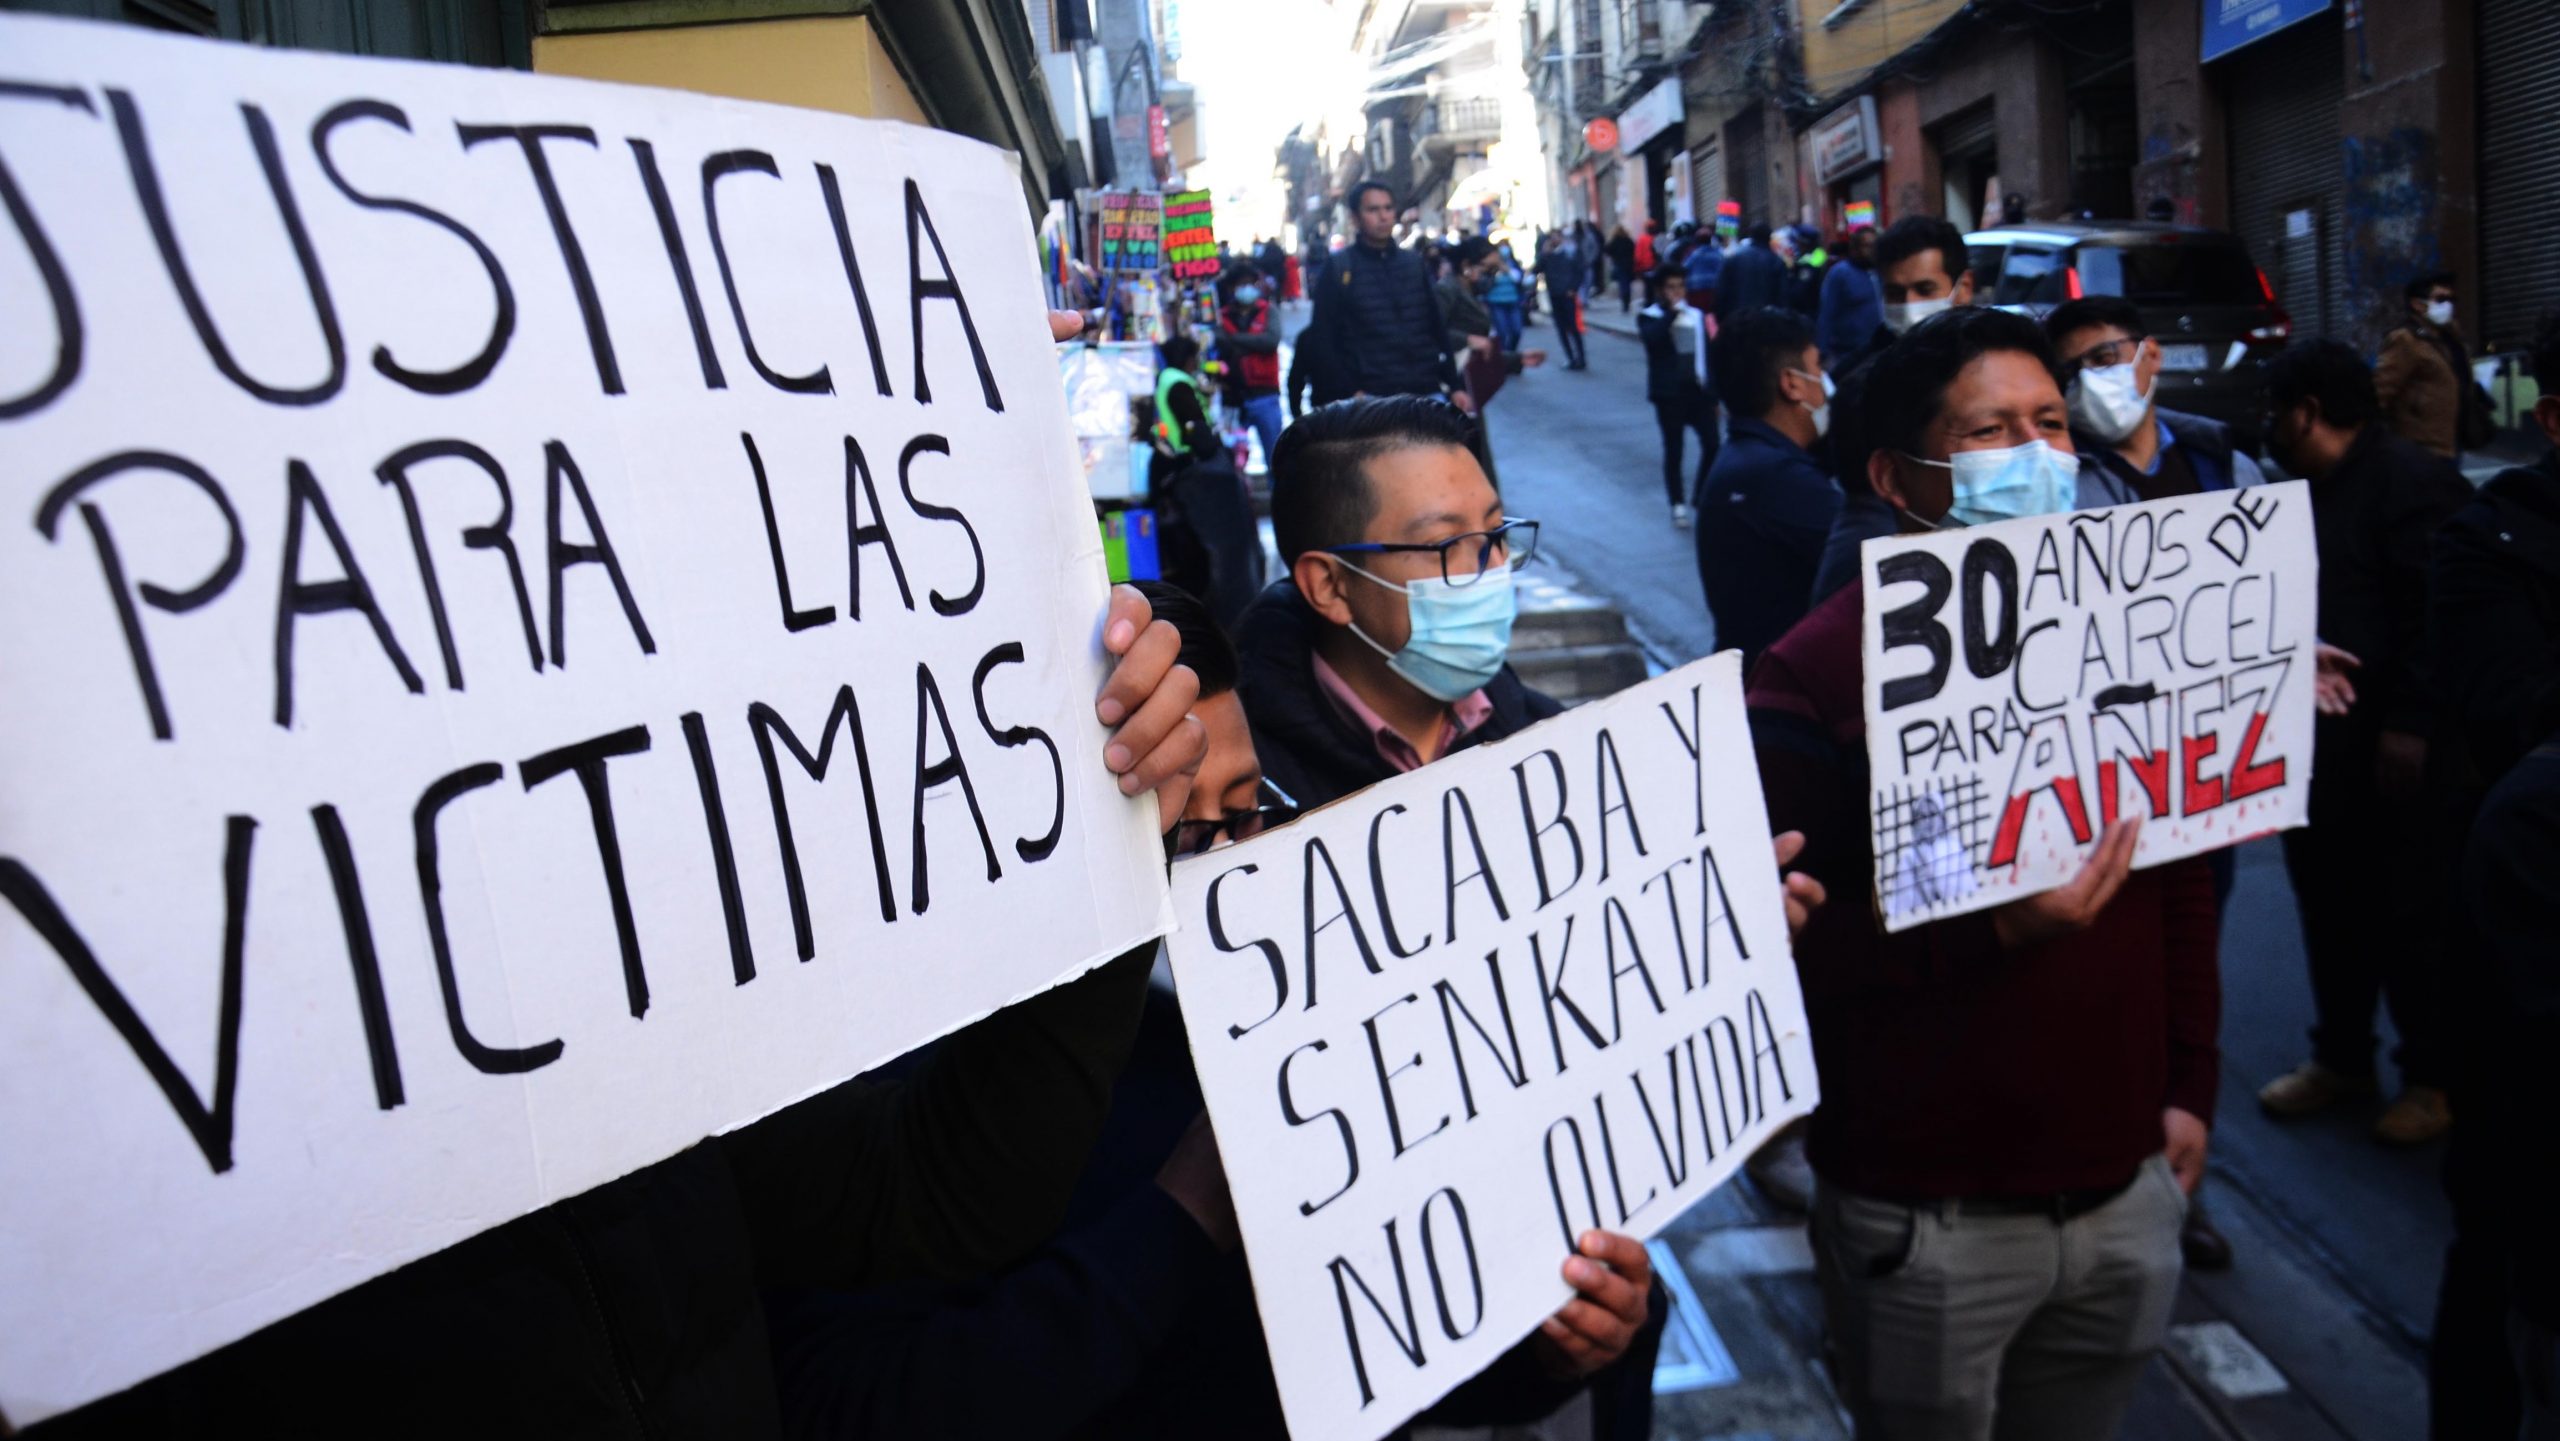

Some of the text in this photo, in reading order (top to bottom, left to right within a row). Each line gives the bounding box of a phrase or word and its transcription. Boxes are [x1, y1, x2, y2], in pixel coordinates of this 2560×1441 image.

[0, 80, 1005, 422] JUSTICIA
[1171, 257, 1220, 279] TIGO
[35, 431, 987, 741] PARA LAS
[1876, 487, 2280, 713] 30 AÑOS DE
[2013, 572, 2297, 712] CARCEL
[0, 641, 1065, 1176] VICTIMAS
[1205, 684, 1707, 1041] SACABA Y
[1899, 657, 2292, 870] PARA AÑEZ
[1277, 846, 1751, 1218] SENKATA
[1325, 988, 1794, 1410] NO OLVIDA
